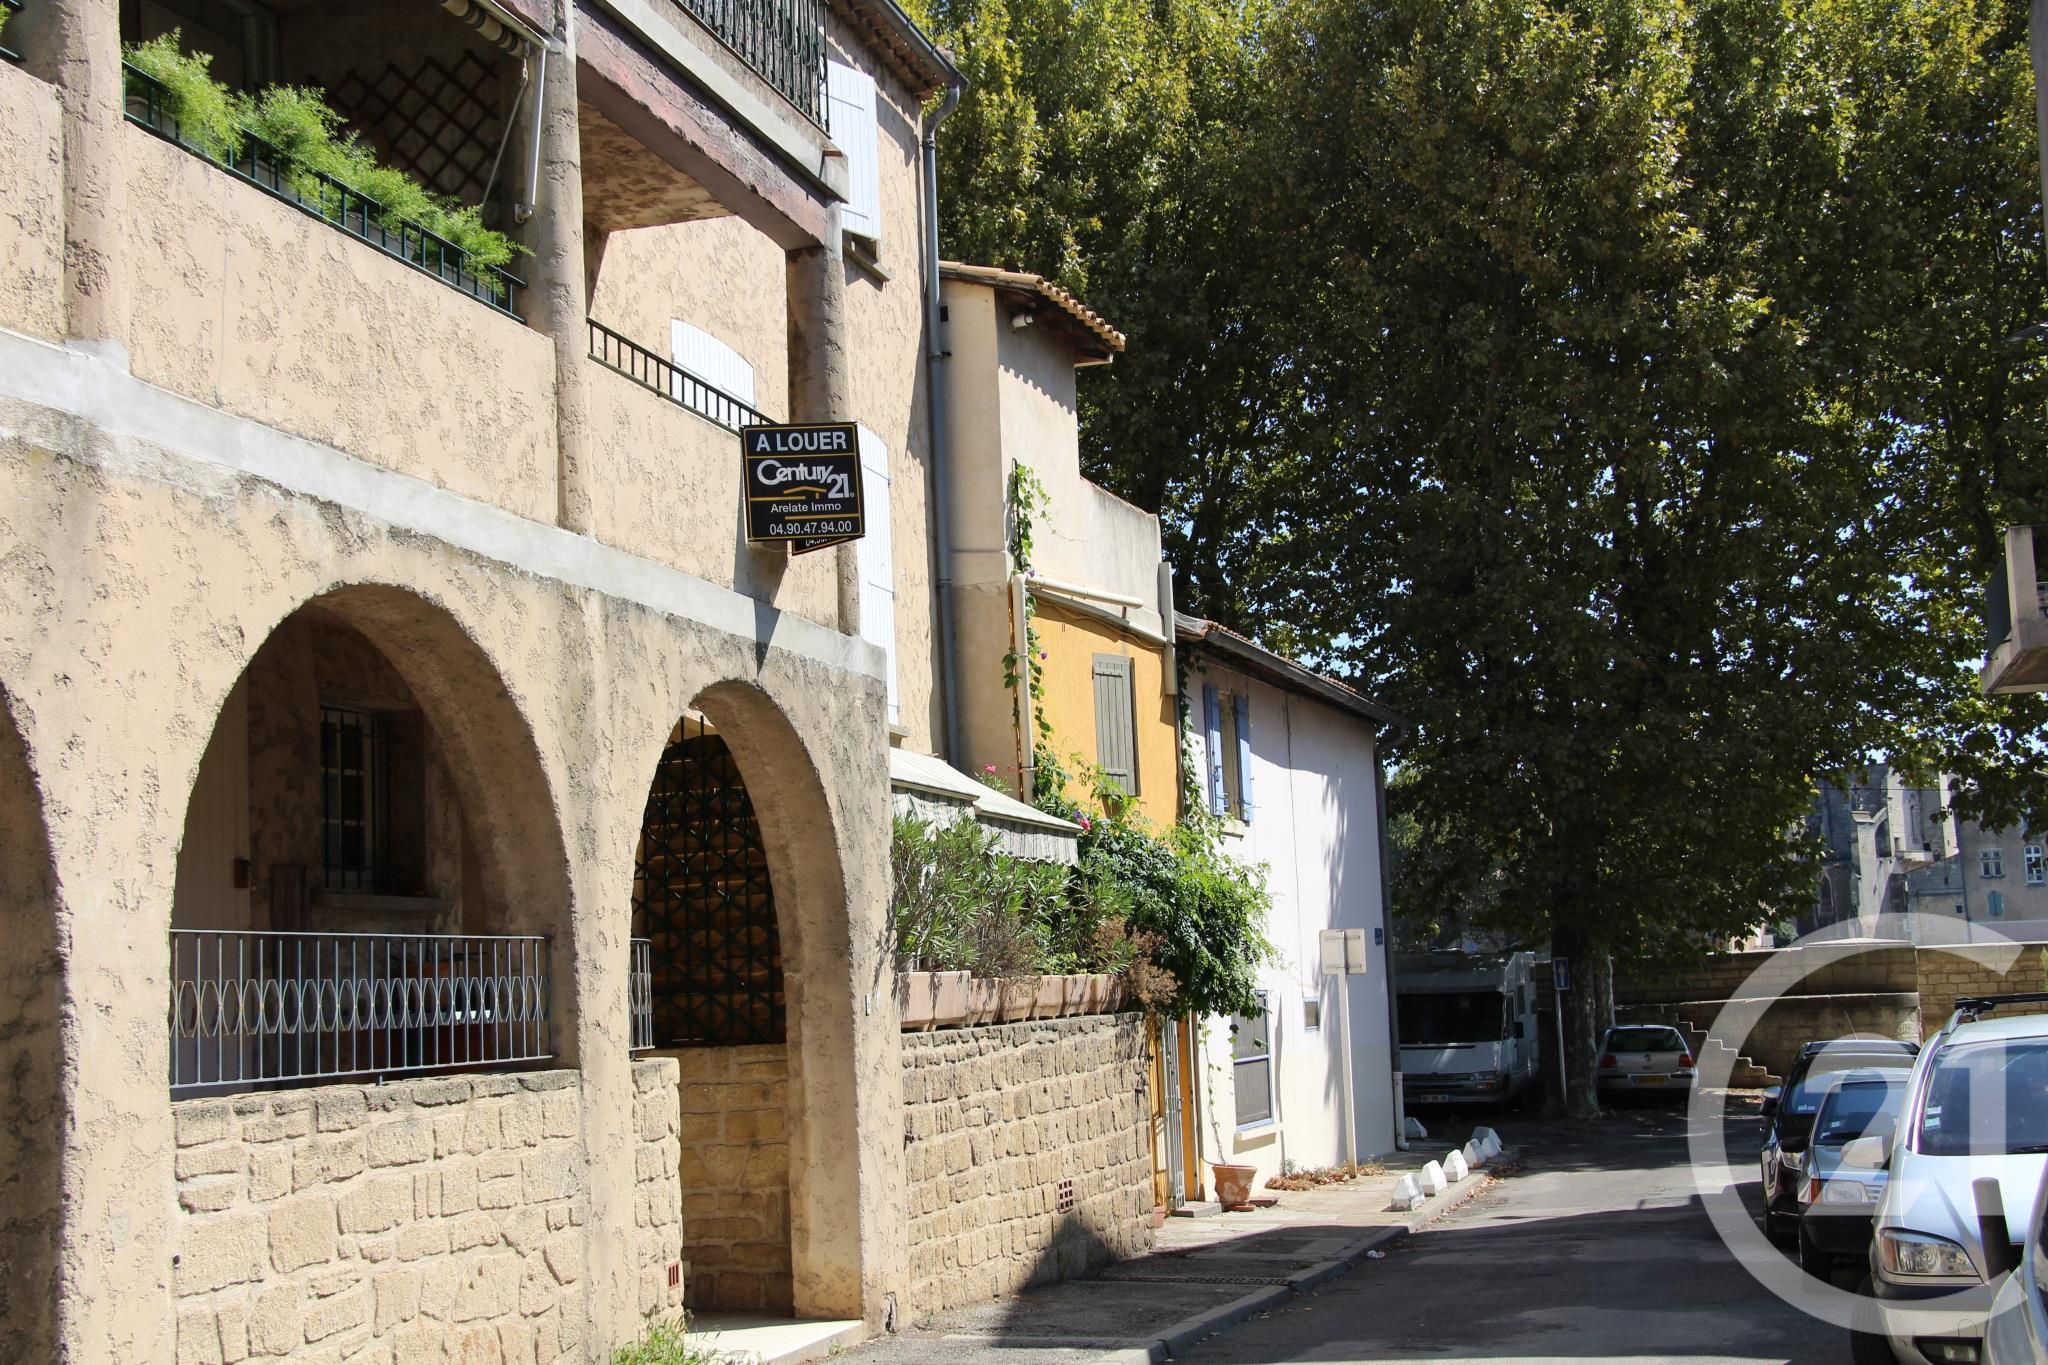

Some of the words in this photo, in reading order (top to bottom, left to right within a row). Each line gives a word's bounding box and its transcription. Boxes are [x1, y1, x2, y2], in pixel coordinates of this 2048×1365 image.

[756, 433, 771, 452] A
[776, 431, 847, 452] LOUER
[756, 459, 834, 485] Century
[826, 473, 850, 499] 21
[770, 502, 809, 513] Arelate
[811, 502, 841, 512] Immo
[769, 520, 852, 535] 04.90.47.94.00
